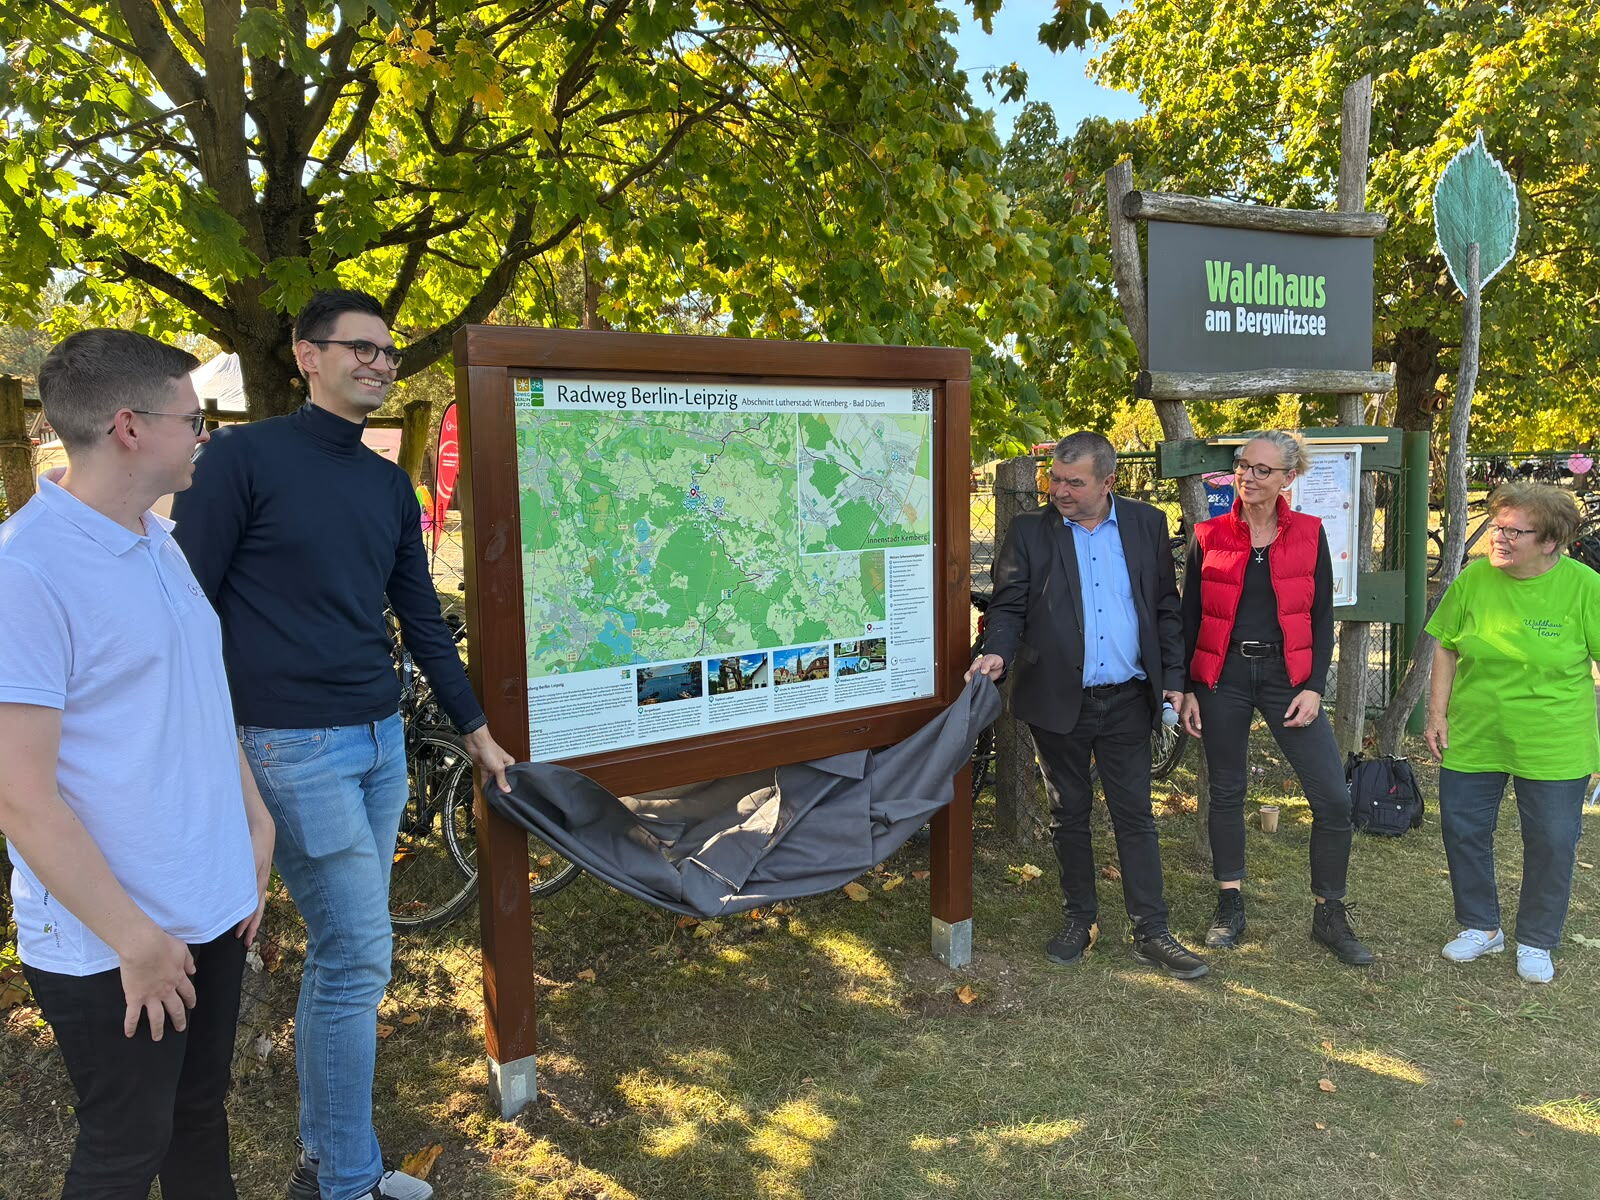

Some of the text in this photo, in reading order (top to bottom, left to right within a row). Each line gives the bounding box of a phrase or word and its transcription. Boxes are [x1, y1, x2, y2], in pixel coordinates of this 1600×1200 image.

[1205, 260, 1327, 309] Waldhaus
[1205, 306, 1327, 336] am Bergwitzsee
[557, 385, 738, 410] Radweg Berlin-Leipzig
[741, 398, 774, 407] Abschnitt
[775, 398, 812, 407] Lutherstadt
[813, 399, 848, 409] Wittenberg
[853, 400, 864, 408] Bad
[865, 400, 885, 408] Düben
[867, 536, 900, 544] Innenstadt
[1523, 618, 1563, 628] Waldhaus
[1532, 627, 1561, 637] Team
